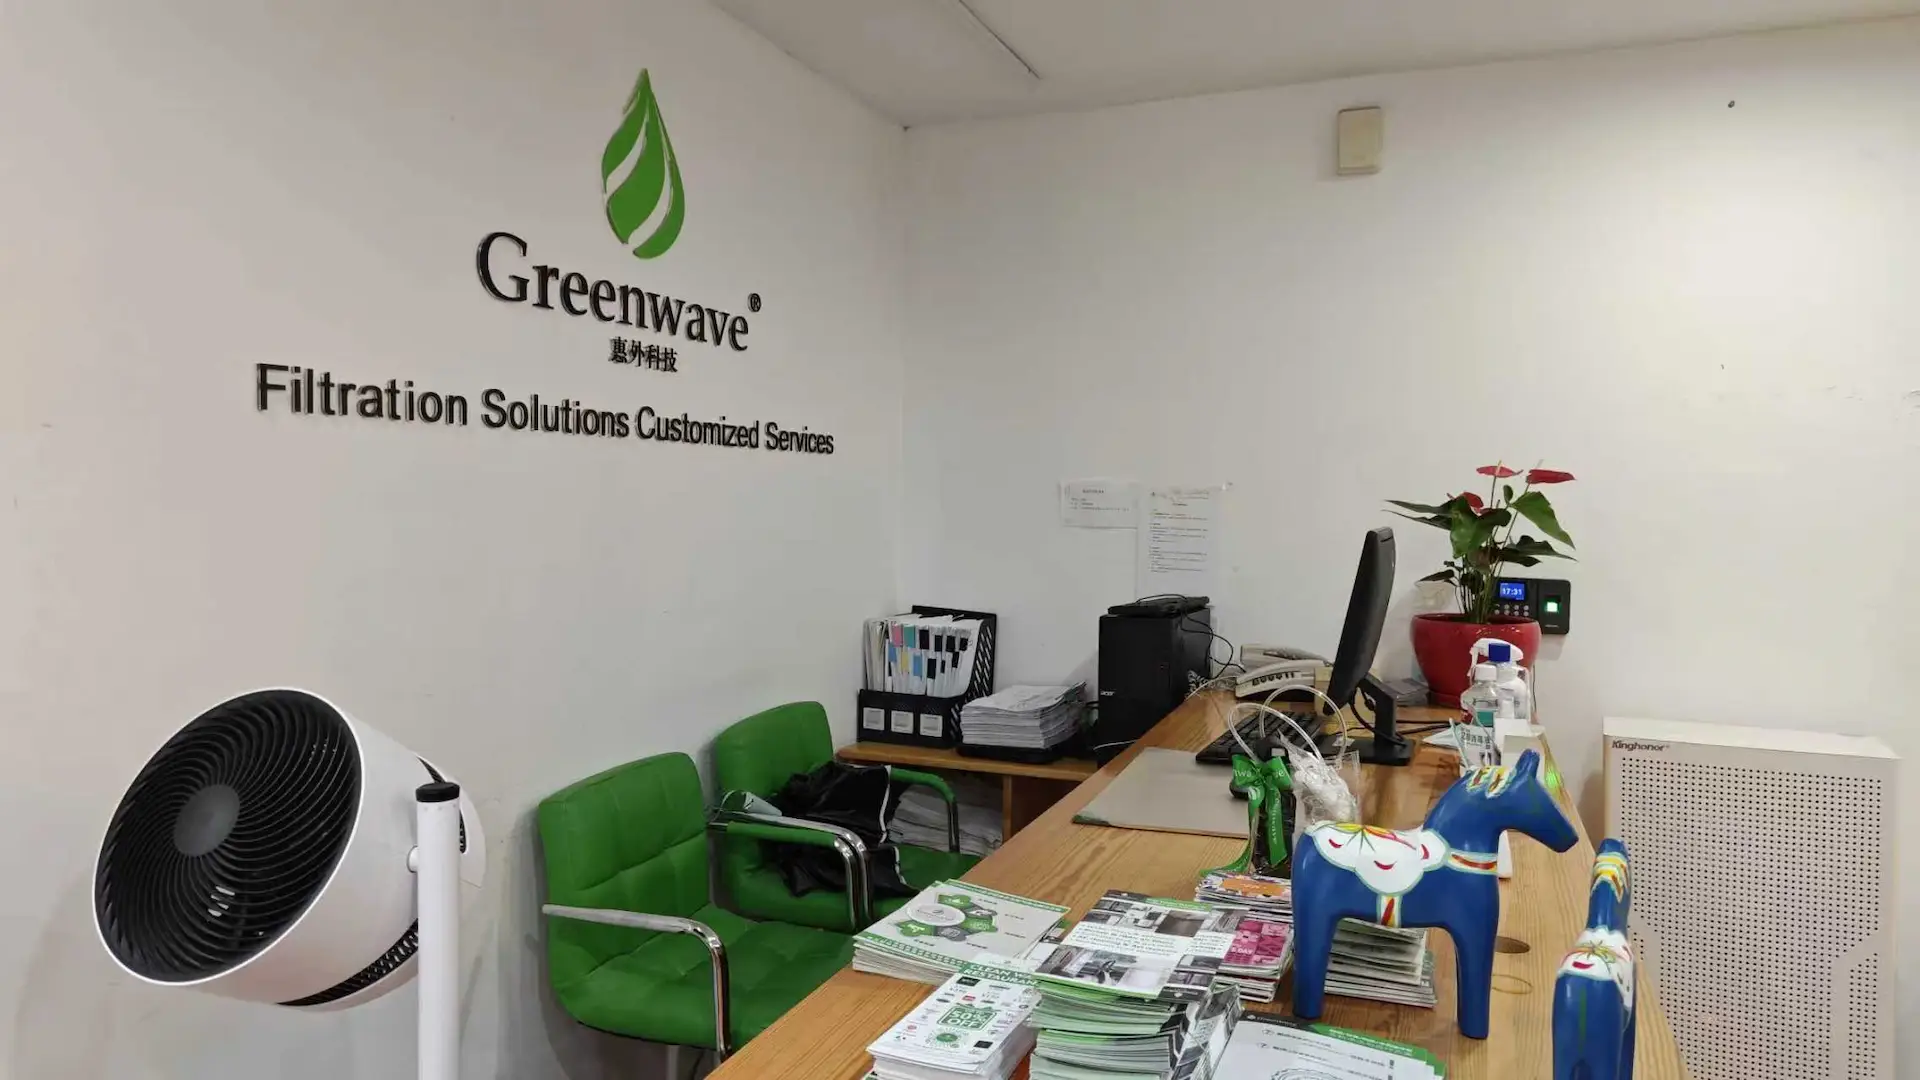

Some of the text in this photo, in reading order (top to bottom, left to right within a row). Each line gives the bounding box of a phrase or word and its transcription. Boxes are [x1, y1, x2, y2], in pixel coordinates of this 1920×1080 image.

[608, 336, 678, 372] 惠外科技
[257, 363, 834, 454] Filtration Solutions Customized Services
[1502, 587, 1522, 596] 17:31
[1612, 740, 1664, 752] Kinghonor
[963, 969, 1039, 986] RESTAURAN
[947, 1018, 982, 1028] OFF
